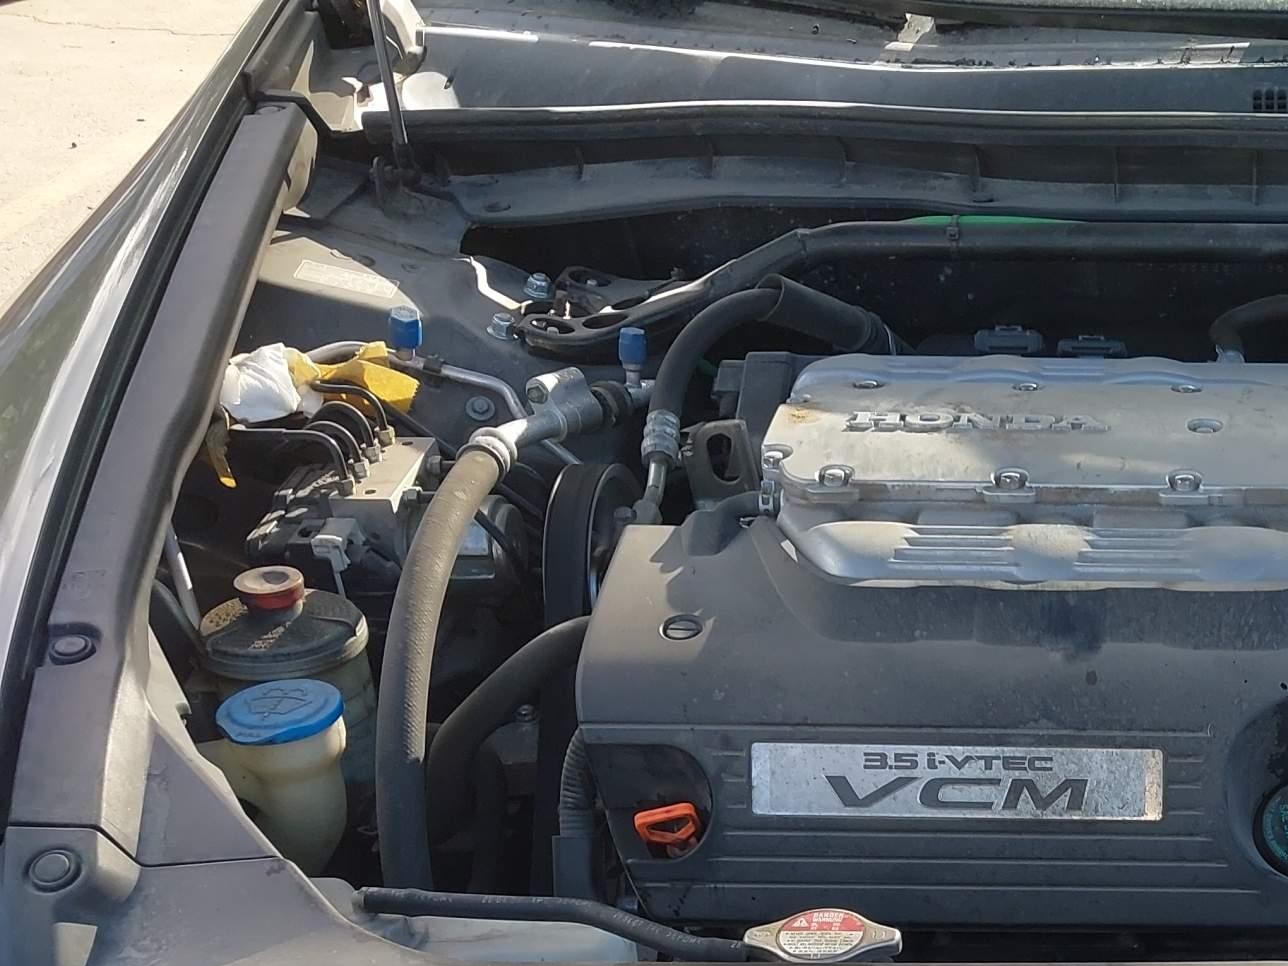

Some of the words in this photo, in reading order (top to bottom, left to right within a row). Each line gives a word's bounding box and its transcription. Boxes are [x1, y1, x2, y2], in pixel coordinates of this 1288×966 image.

[843, 411, 1110, 432] HONDA
[863, 751, 918, 770] 3.5
[926, 752, 1054, 771] i-VTEC
[823, 774, 1088, 812] VCM
